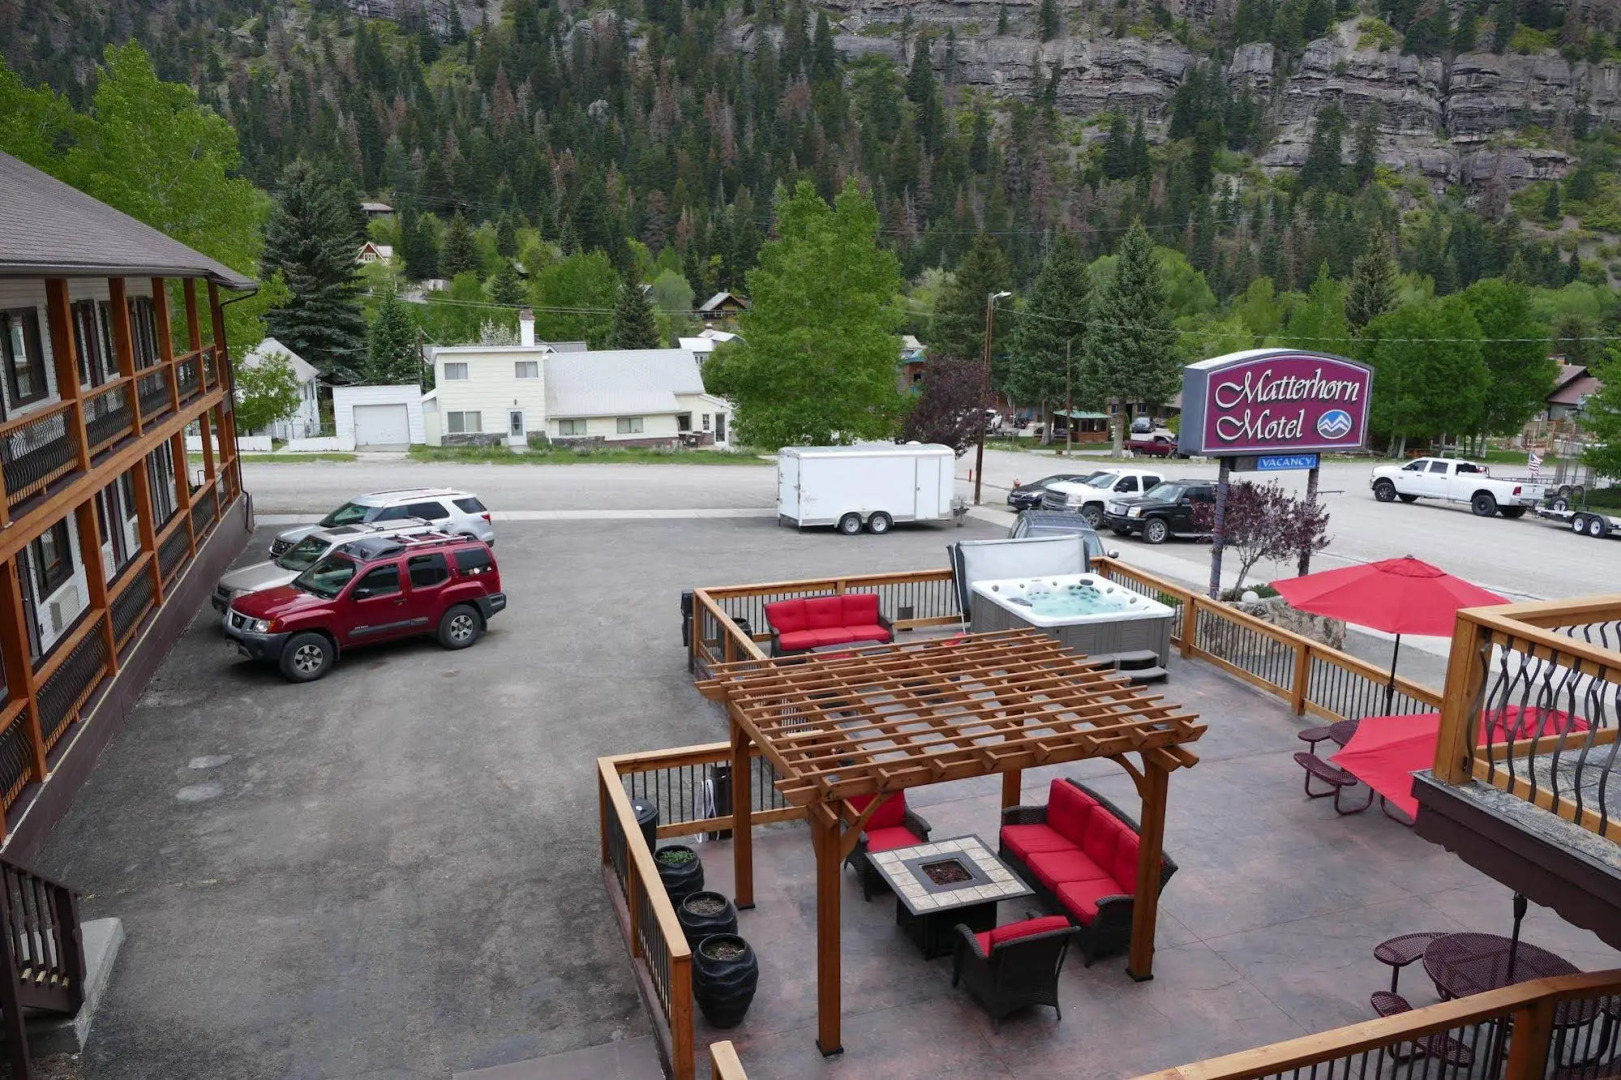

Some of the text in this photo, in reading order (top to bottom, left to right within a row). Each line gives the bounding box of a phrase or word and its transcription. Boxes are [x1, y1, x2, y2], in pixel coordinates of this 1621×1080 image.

[1215, 368, 1360, 409] Matterhorn
[1216, 408, 1305, 440] Motel
[1262, 457, 1314, 467] VACANCY
